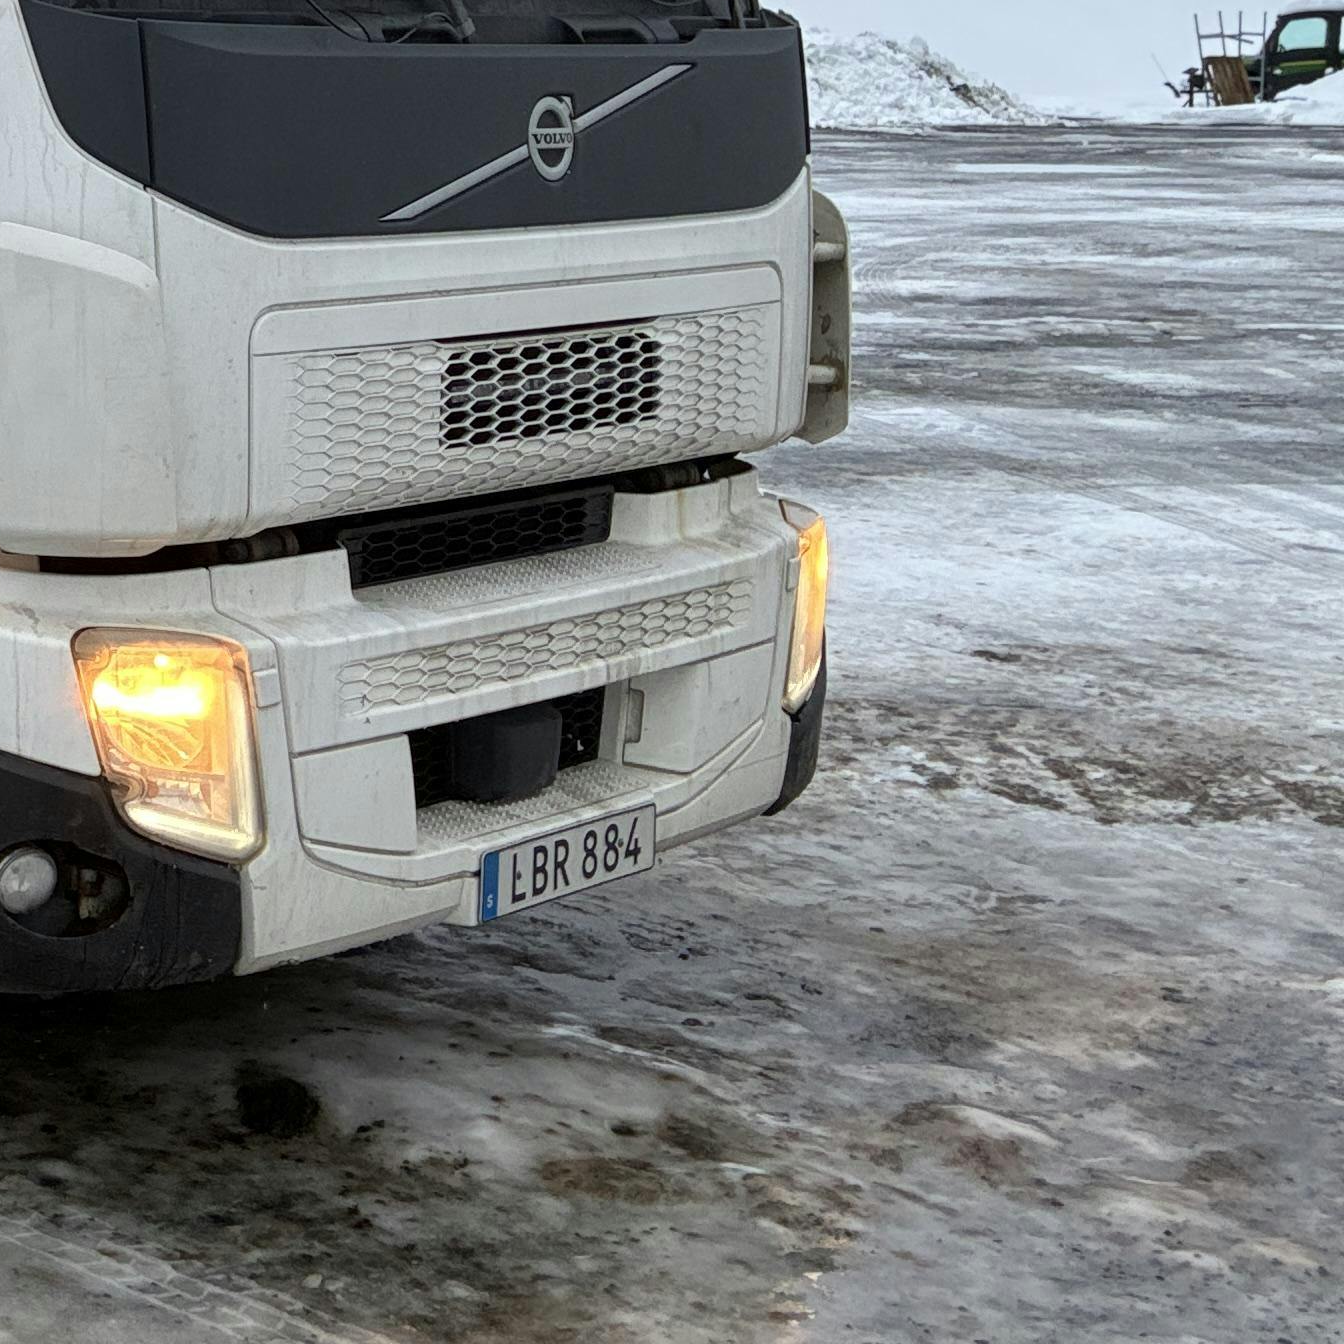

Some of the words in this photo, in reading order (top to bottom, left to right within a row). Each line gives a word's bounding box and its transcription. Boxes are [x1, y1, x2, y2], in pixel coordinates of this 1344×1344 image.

[531, 133, 573, 145] VOLVO
[511, 838, 570, 905] LBR
[581, 816, 642, 880] 884
